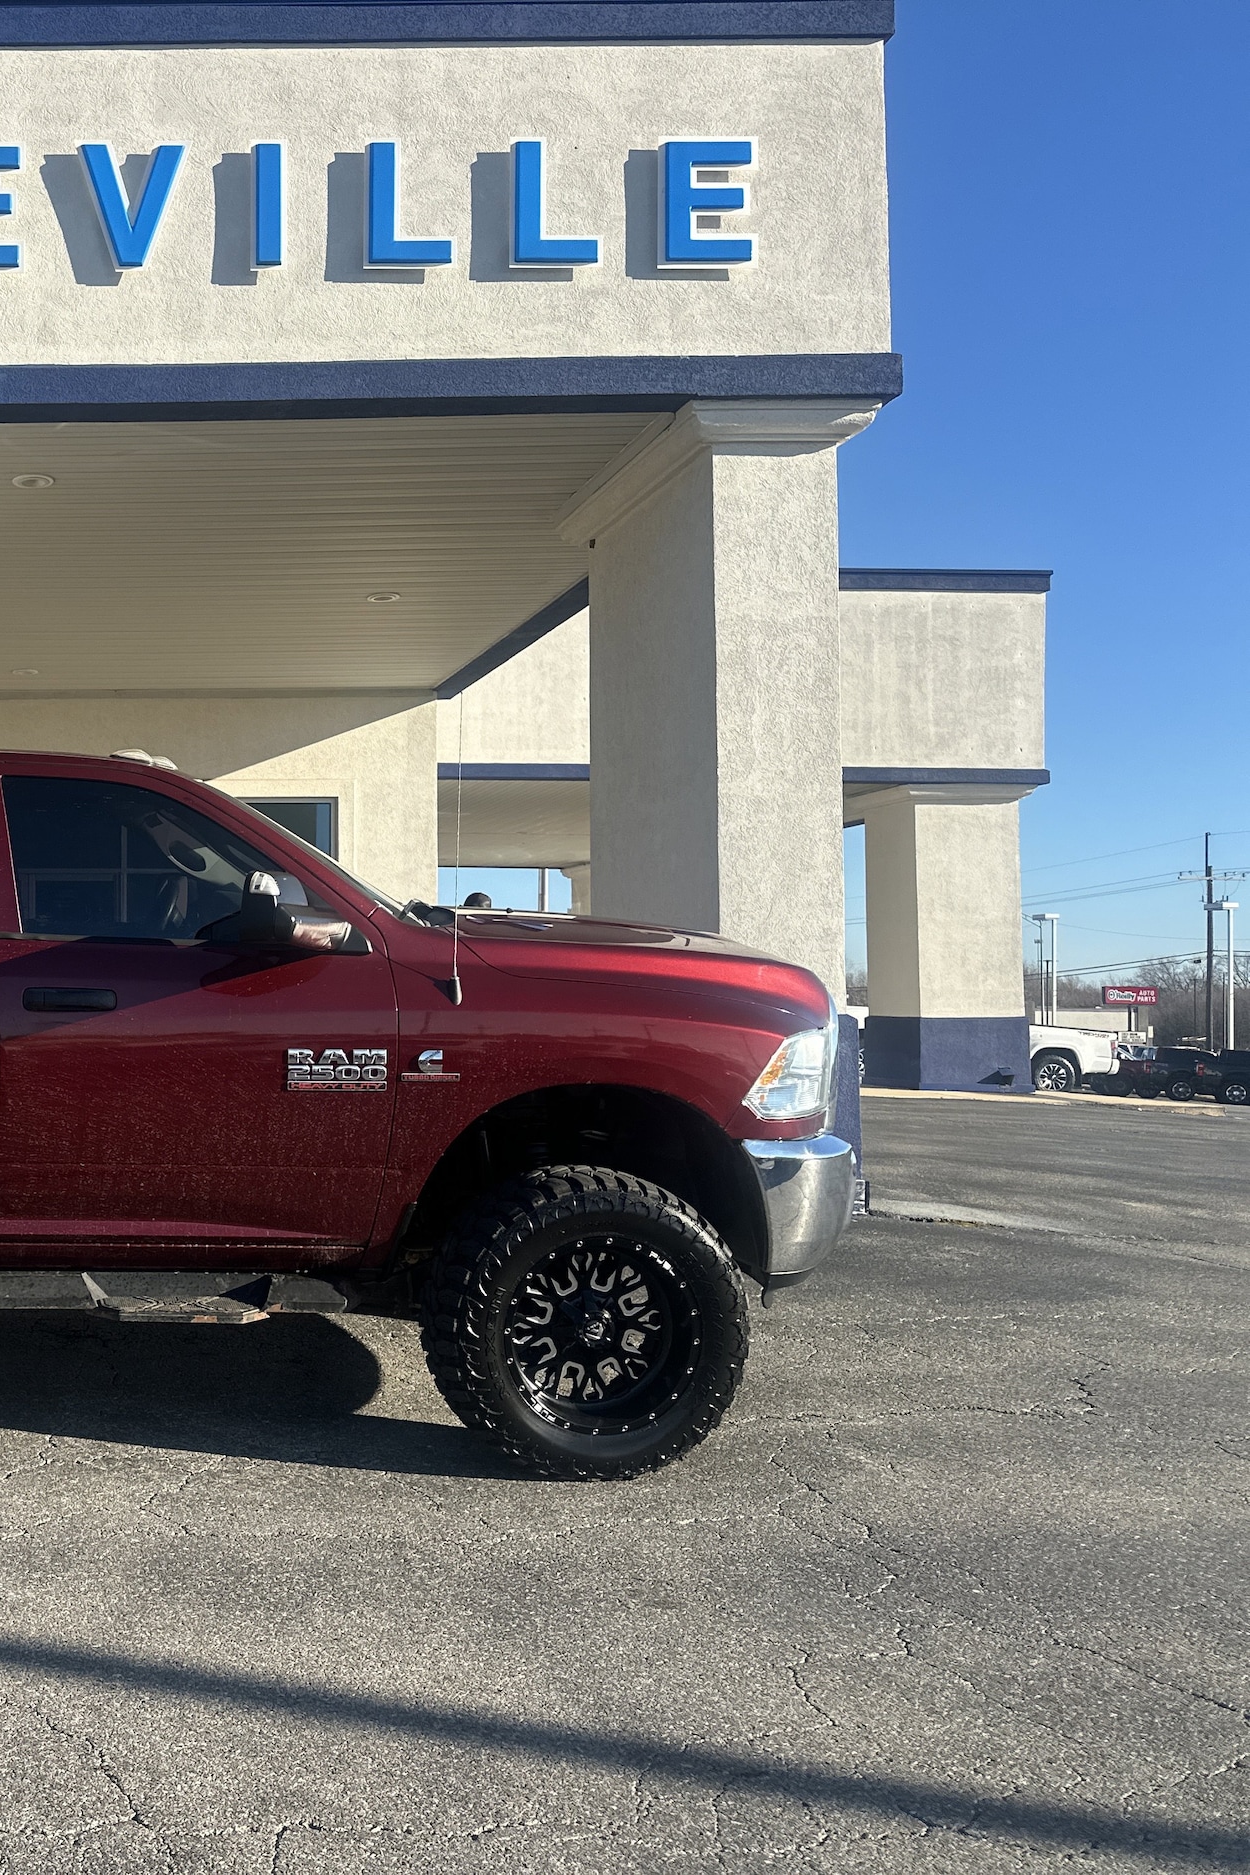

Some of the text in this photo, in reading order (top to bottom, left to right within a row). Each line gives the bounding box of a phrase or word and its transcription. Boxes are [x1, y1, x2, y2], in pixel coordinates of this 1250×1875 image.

[1107, 989, 1137, 1002] O'Reilly
[287, 1048, 388, 1065] RAM
[287, 1065, 388, 1081] 2500
[290, 1082, 383, 1090] HEAVY DUTY
